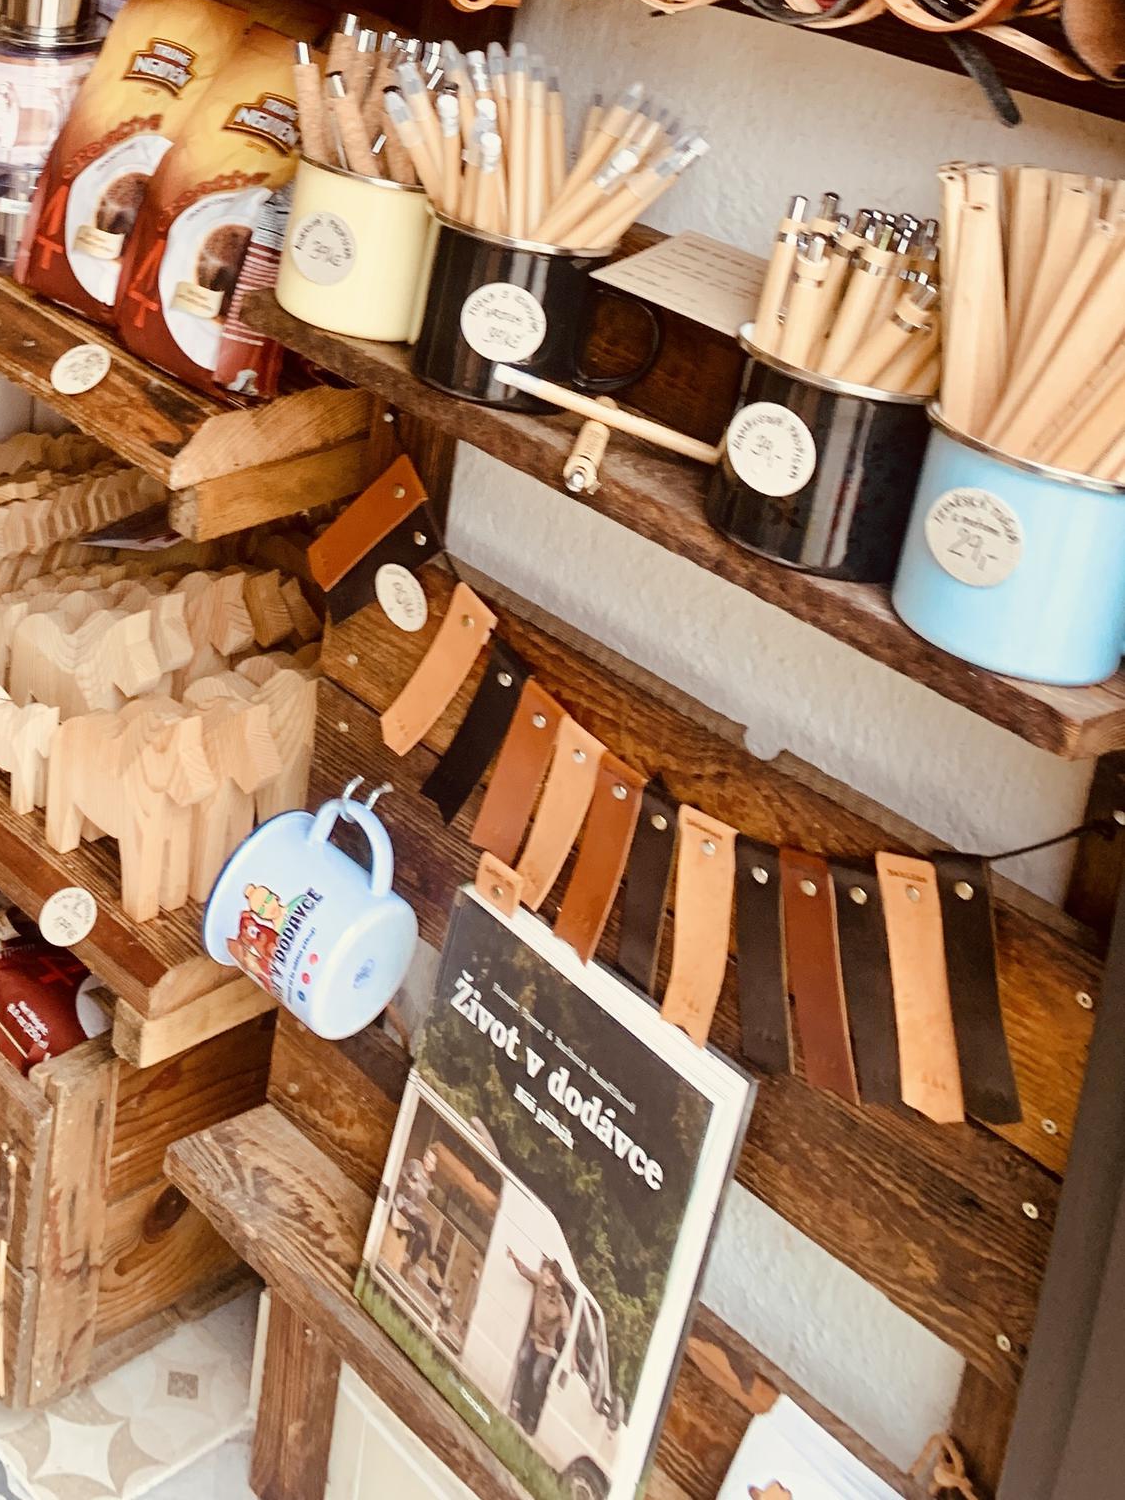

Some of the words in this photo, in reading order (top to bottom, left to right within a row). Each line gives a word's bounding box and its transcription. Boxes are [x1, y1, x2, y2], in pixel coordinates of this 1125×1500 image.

[450, 969, 521, 1062] Život
[526, 1046, 546, 1079] v
[547, 1066, 664, 1192] dodávce
